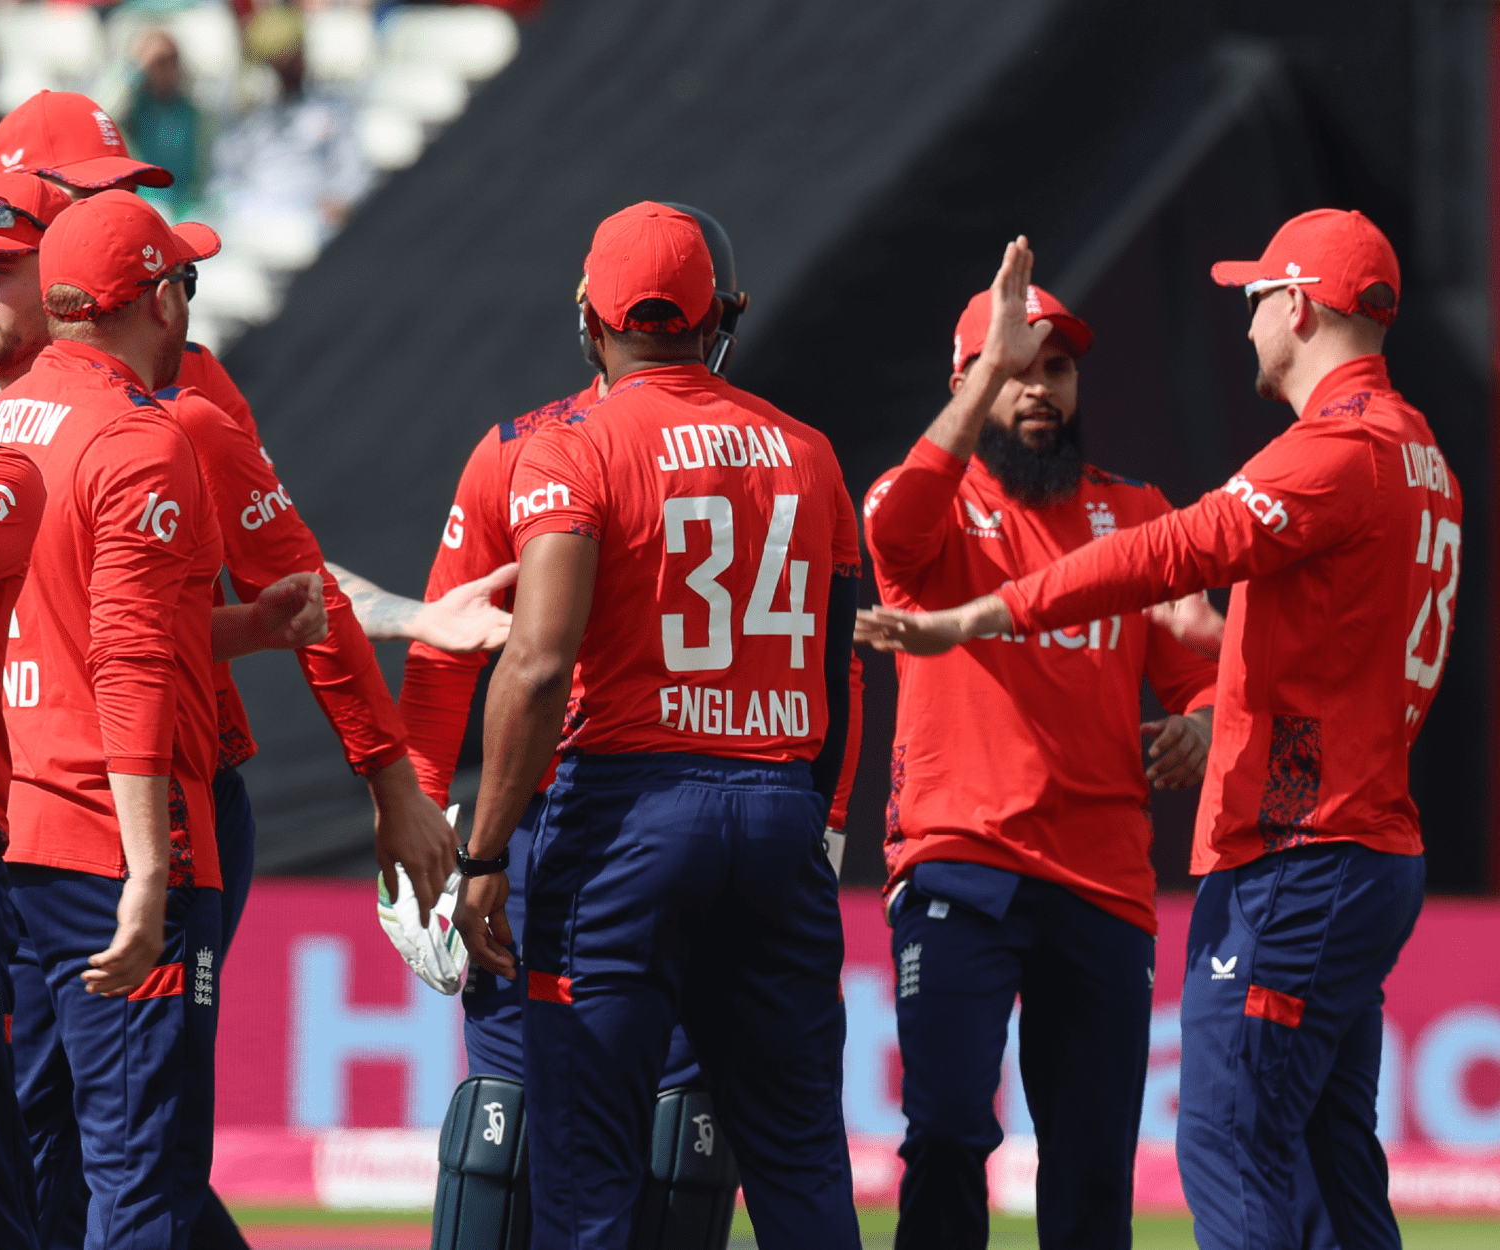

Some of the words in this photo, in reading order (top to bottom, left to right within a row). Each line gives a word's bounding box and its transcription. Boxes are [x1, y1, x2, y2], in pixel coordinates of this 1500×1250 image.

[657, 424, 793, 472] JORDAN
[136, 491, 181, 543] IG
[509, 481, 571, 527] inch
[1221, 473, 1289, 534] inch
[661, 494, 816, 673] 34
[659, 686, 810, 738] ENGLAND
